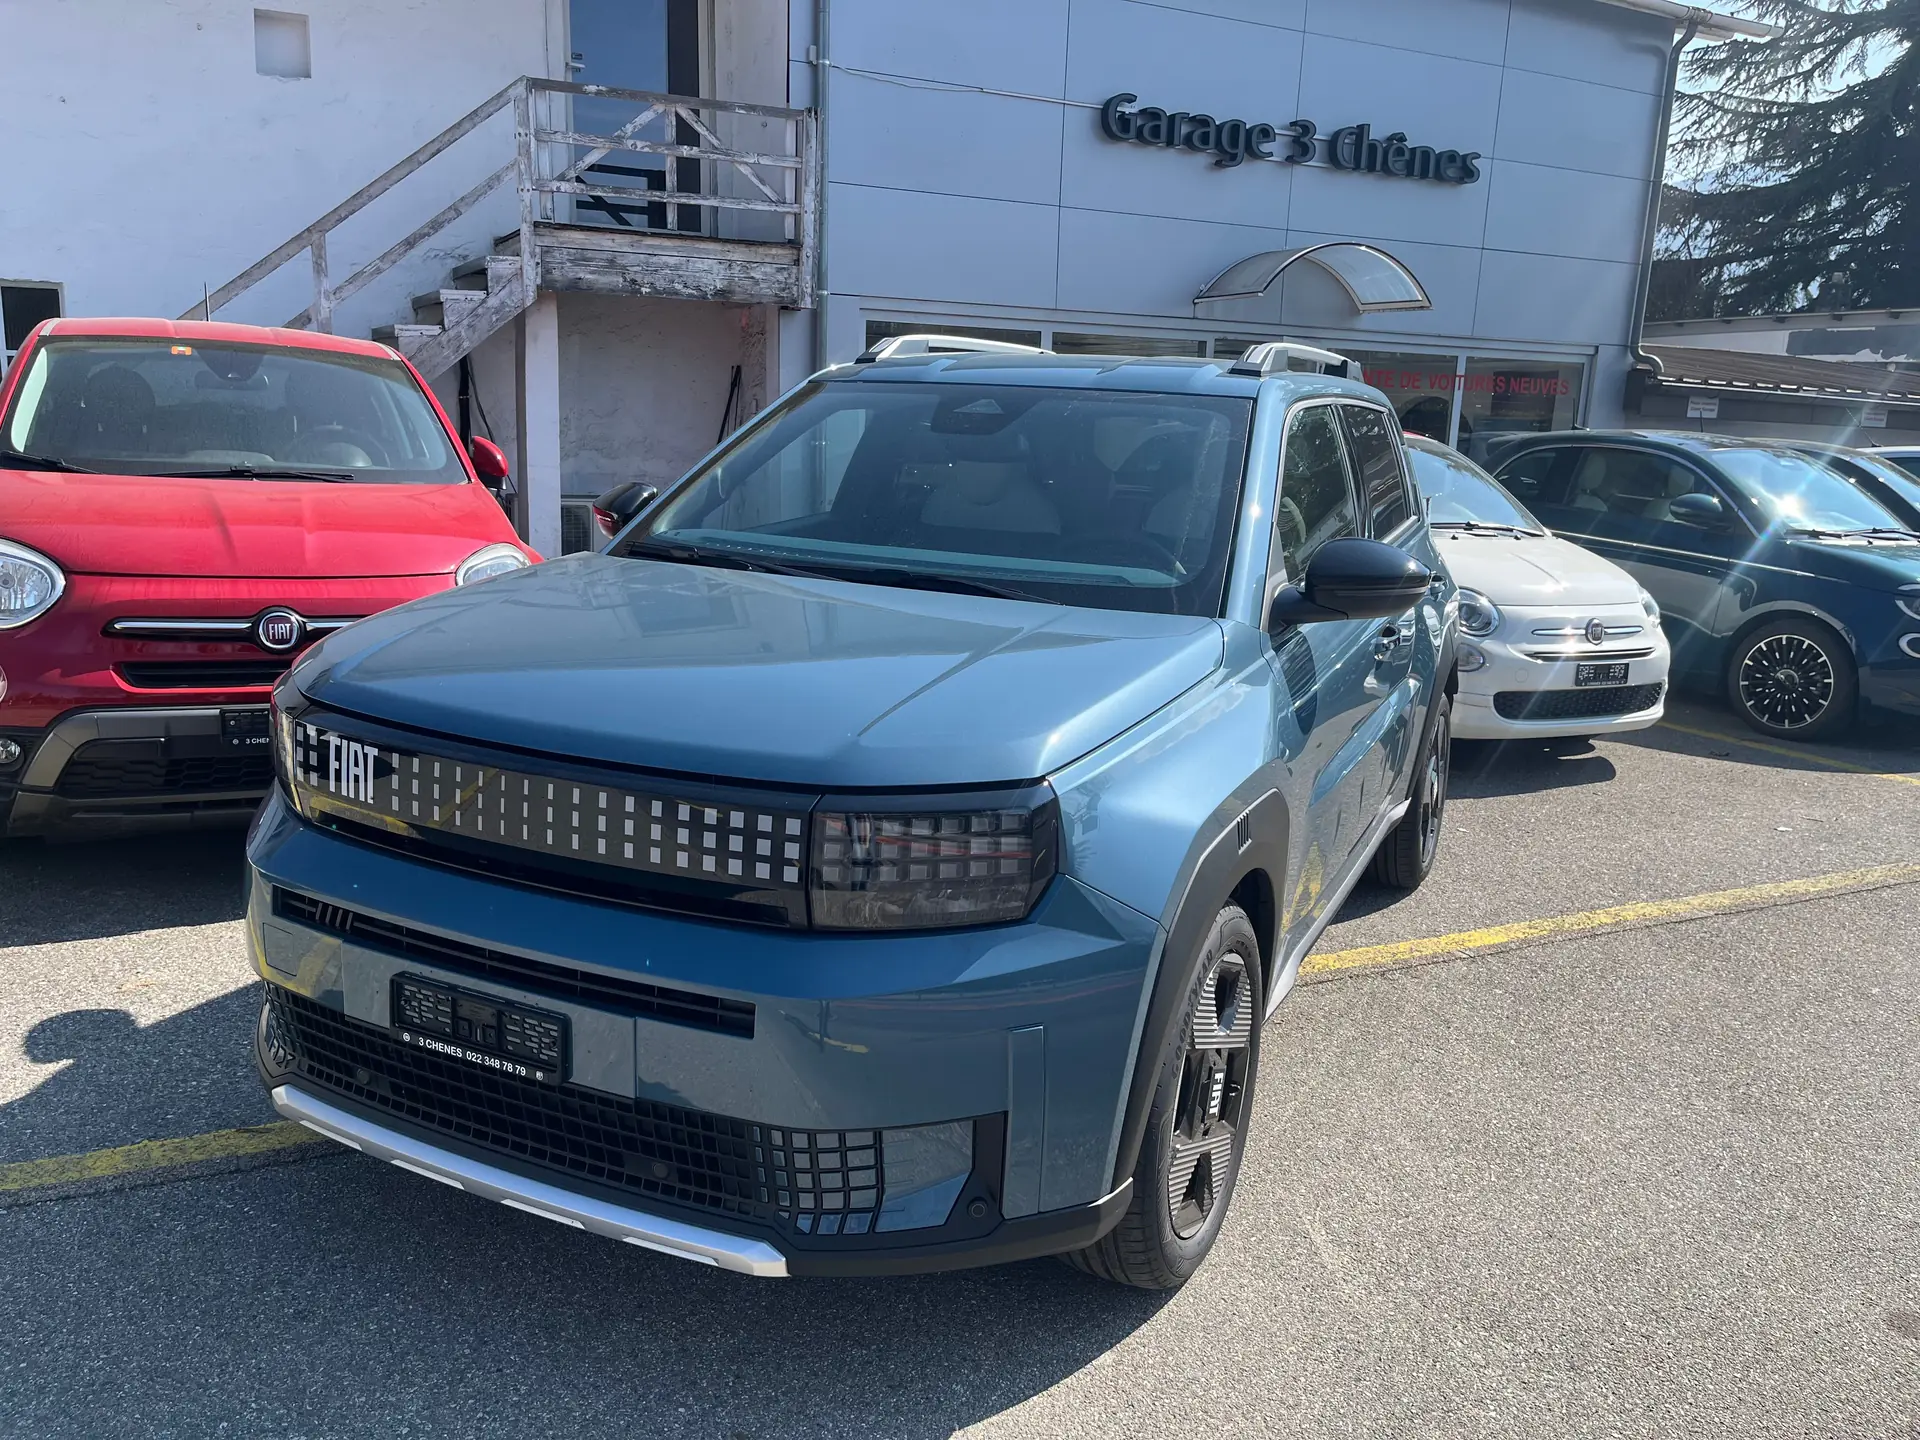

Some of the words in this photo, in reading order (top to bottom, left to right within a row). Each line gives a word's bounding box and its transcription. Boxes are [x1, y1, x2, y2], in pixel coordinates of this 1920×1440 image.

[1101, 92, 1277, 168] Garage
[1285, 119, 1316, 165] 3
[1328, 123, 1482, 185] Chênes
[1363, 367, 1396, 389] NTE
[1400, 370, 1422, 390] DE
[1428, 372, 1505, 394] VOITURES
[1509, 376, 1570, 396] NEUVES
[268, 623, 291, 640] FIAT
[329, 735, 379, 804] FIAT
[418, 1037, 424, 1047] 3
[425, 1039, 463, 1058] CHENES
[466, 1050, 482, 1063] 022
[484, 1056, 500, 1069] 348
[502, 1061, 513, 1072] 78
[515, 1064, 526, 1076] 79
[1209, 1072, 1224, 1116] FIAT
